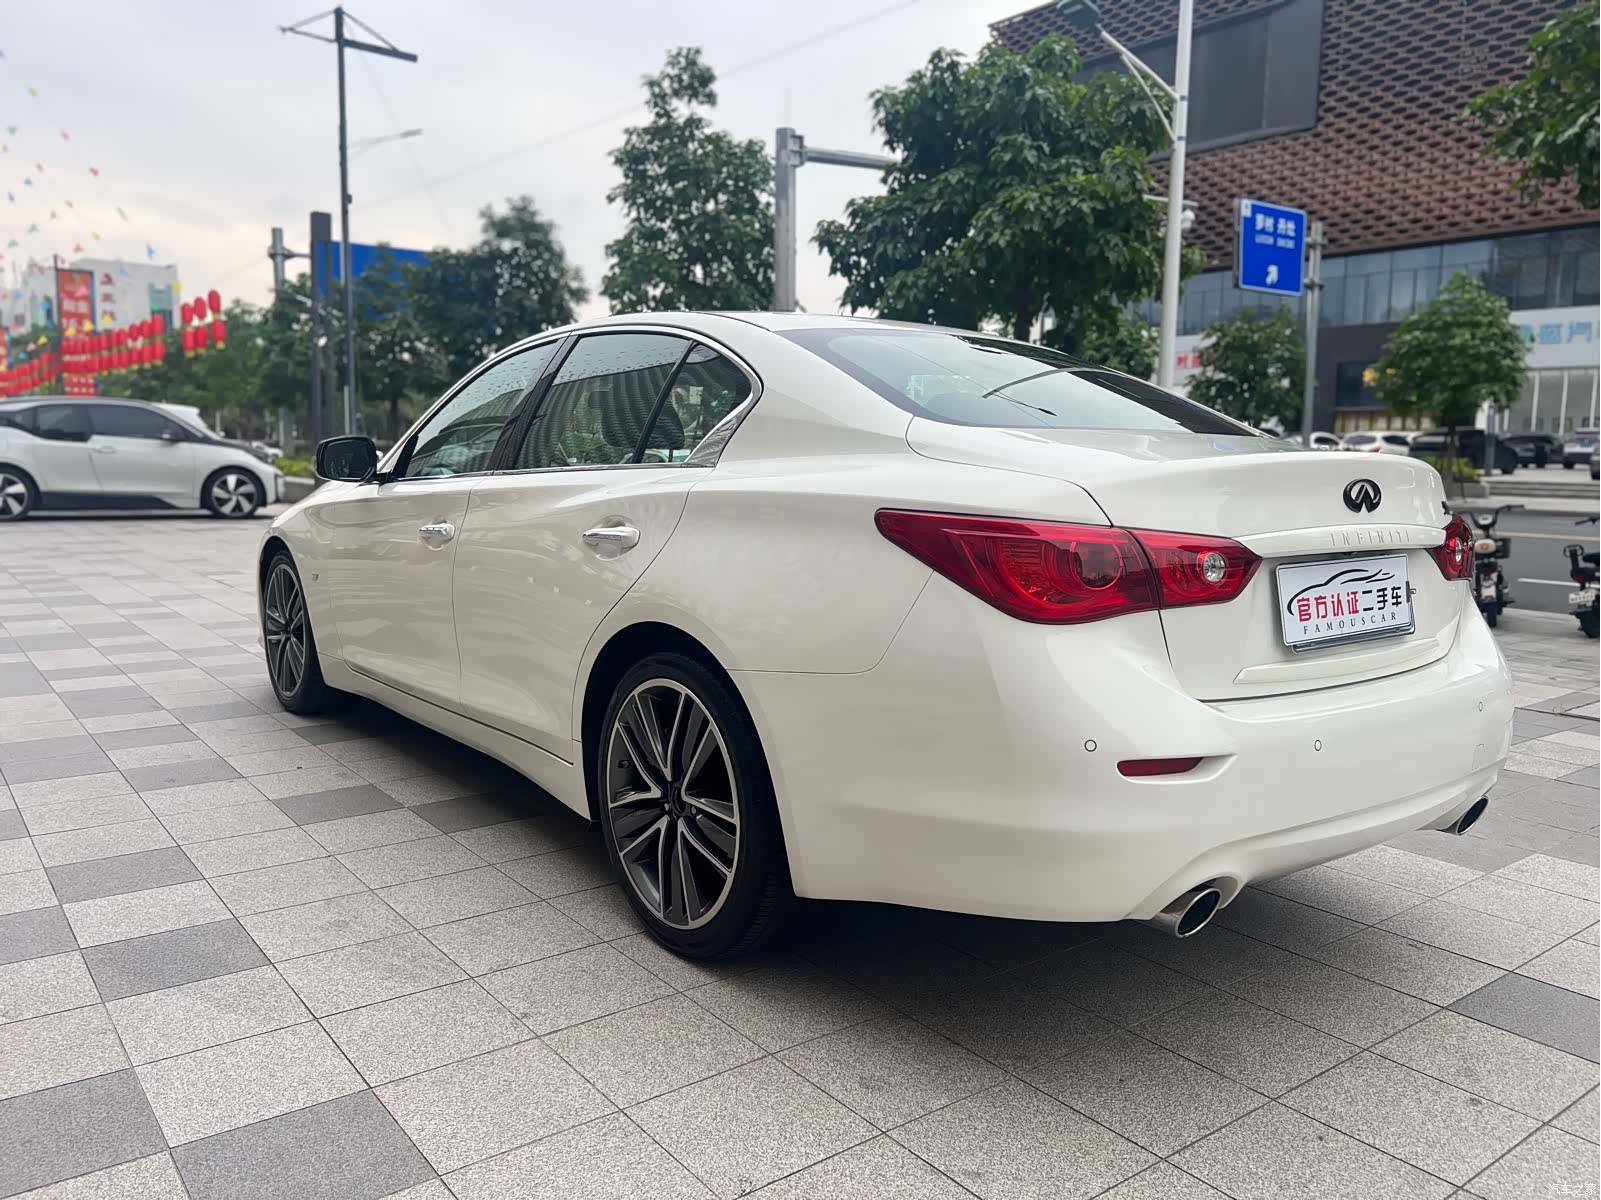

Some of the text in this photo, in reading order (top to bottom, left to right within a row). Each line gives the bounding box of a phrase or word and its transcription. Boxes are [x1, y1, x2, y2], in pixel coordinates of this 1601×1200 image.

[1331, 530, 1409, 546] INFINITI
[1297, 586, 1402, 622] 官方认证二手车
[1303, 611, 1397, 635] FAMOUSCAR
